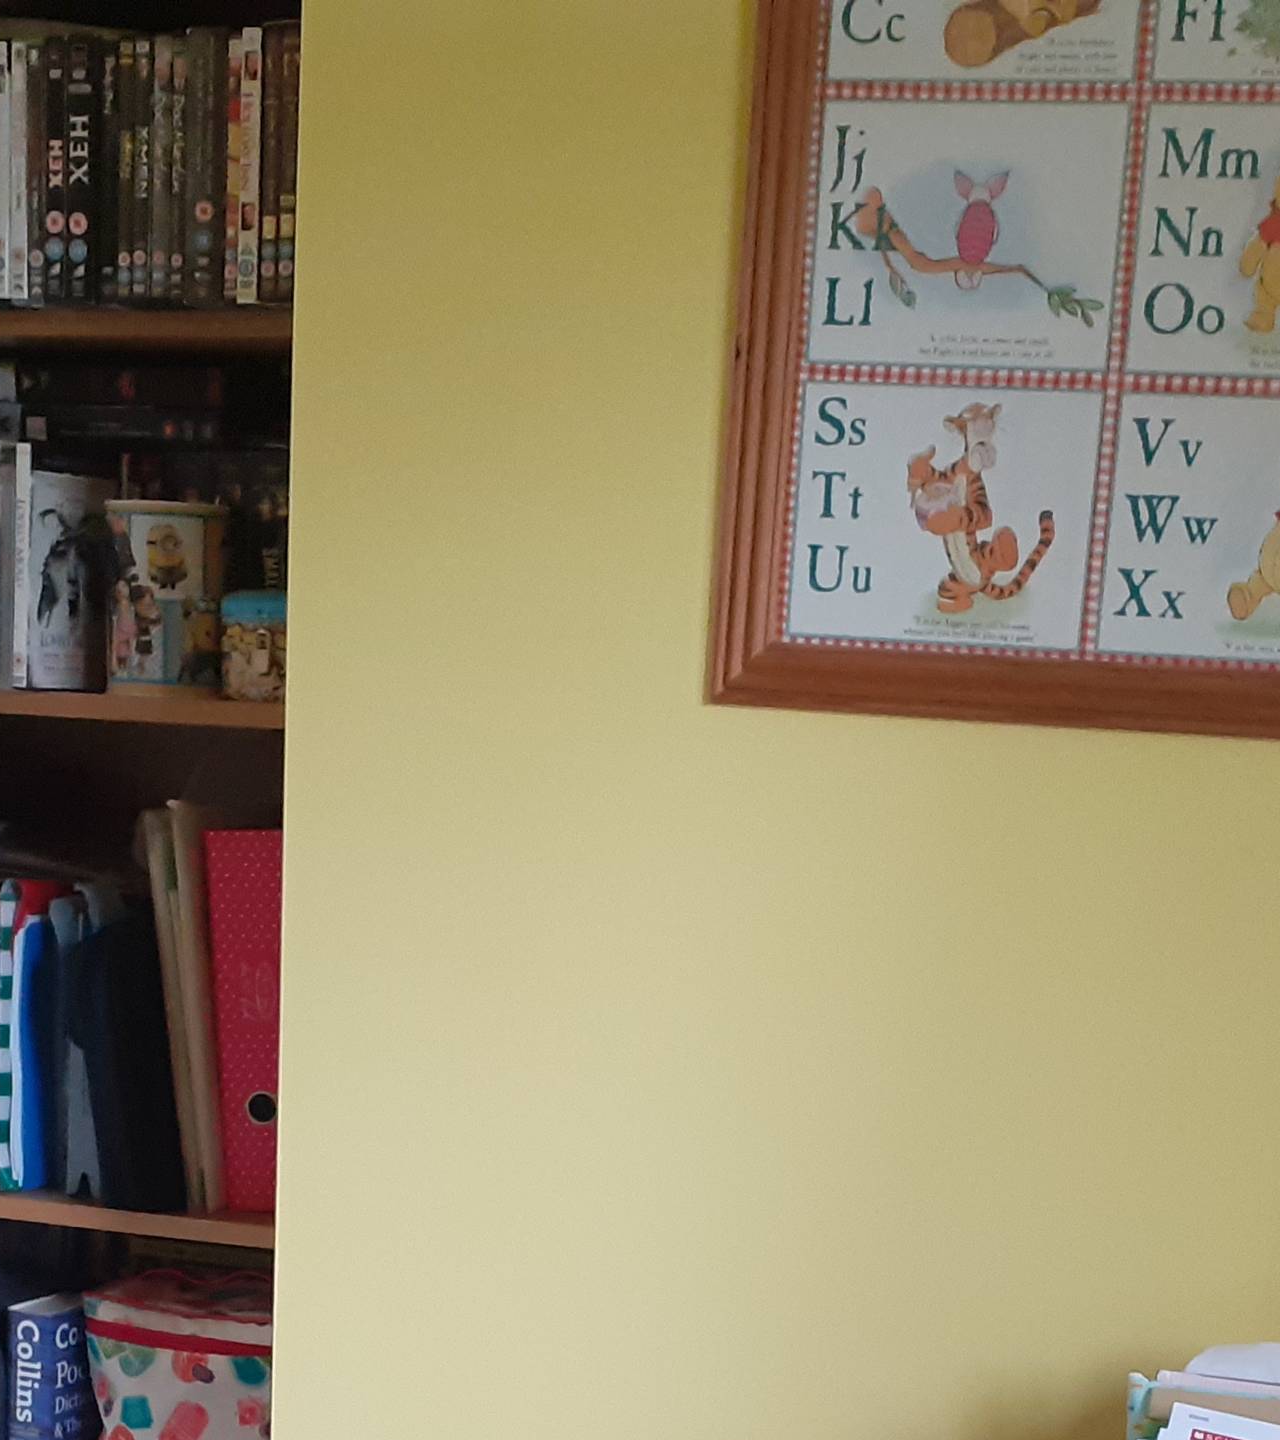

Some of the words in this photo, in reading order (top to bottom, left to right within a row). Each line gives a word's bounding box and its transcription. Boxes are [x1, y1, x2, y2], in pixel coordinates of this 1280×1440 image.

[68, 115, 90, 186] HEX
[830, 125, 868, 193] Jj
[1158, 128, 1261, 181] Mm
[827, 203, 899, 253] Kk
[1150, 207, 1223, 258] Nn
[1144, 282, 1225, 336] Oo
[814, 396, 867, 448] Ss
[1133, 417, 1204, 468] Vv
[811, 471, 865, 520] Tt
[1126, 494, 1218, 546] Ww
[807, 544, 873, 594] Uu
[1114, 568, 1184, 620] Xx
[55, 1322, 79, 1350] Co
[16, 1320, 43, 1424] Collins
[54, 1394, 81, 1415] Dict
